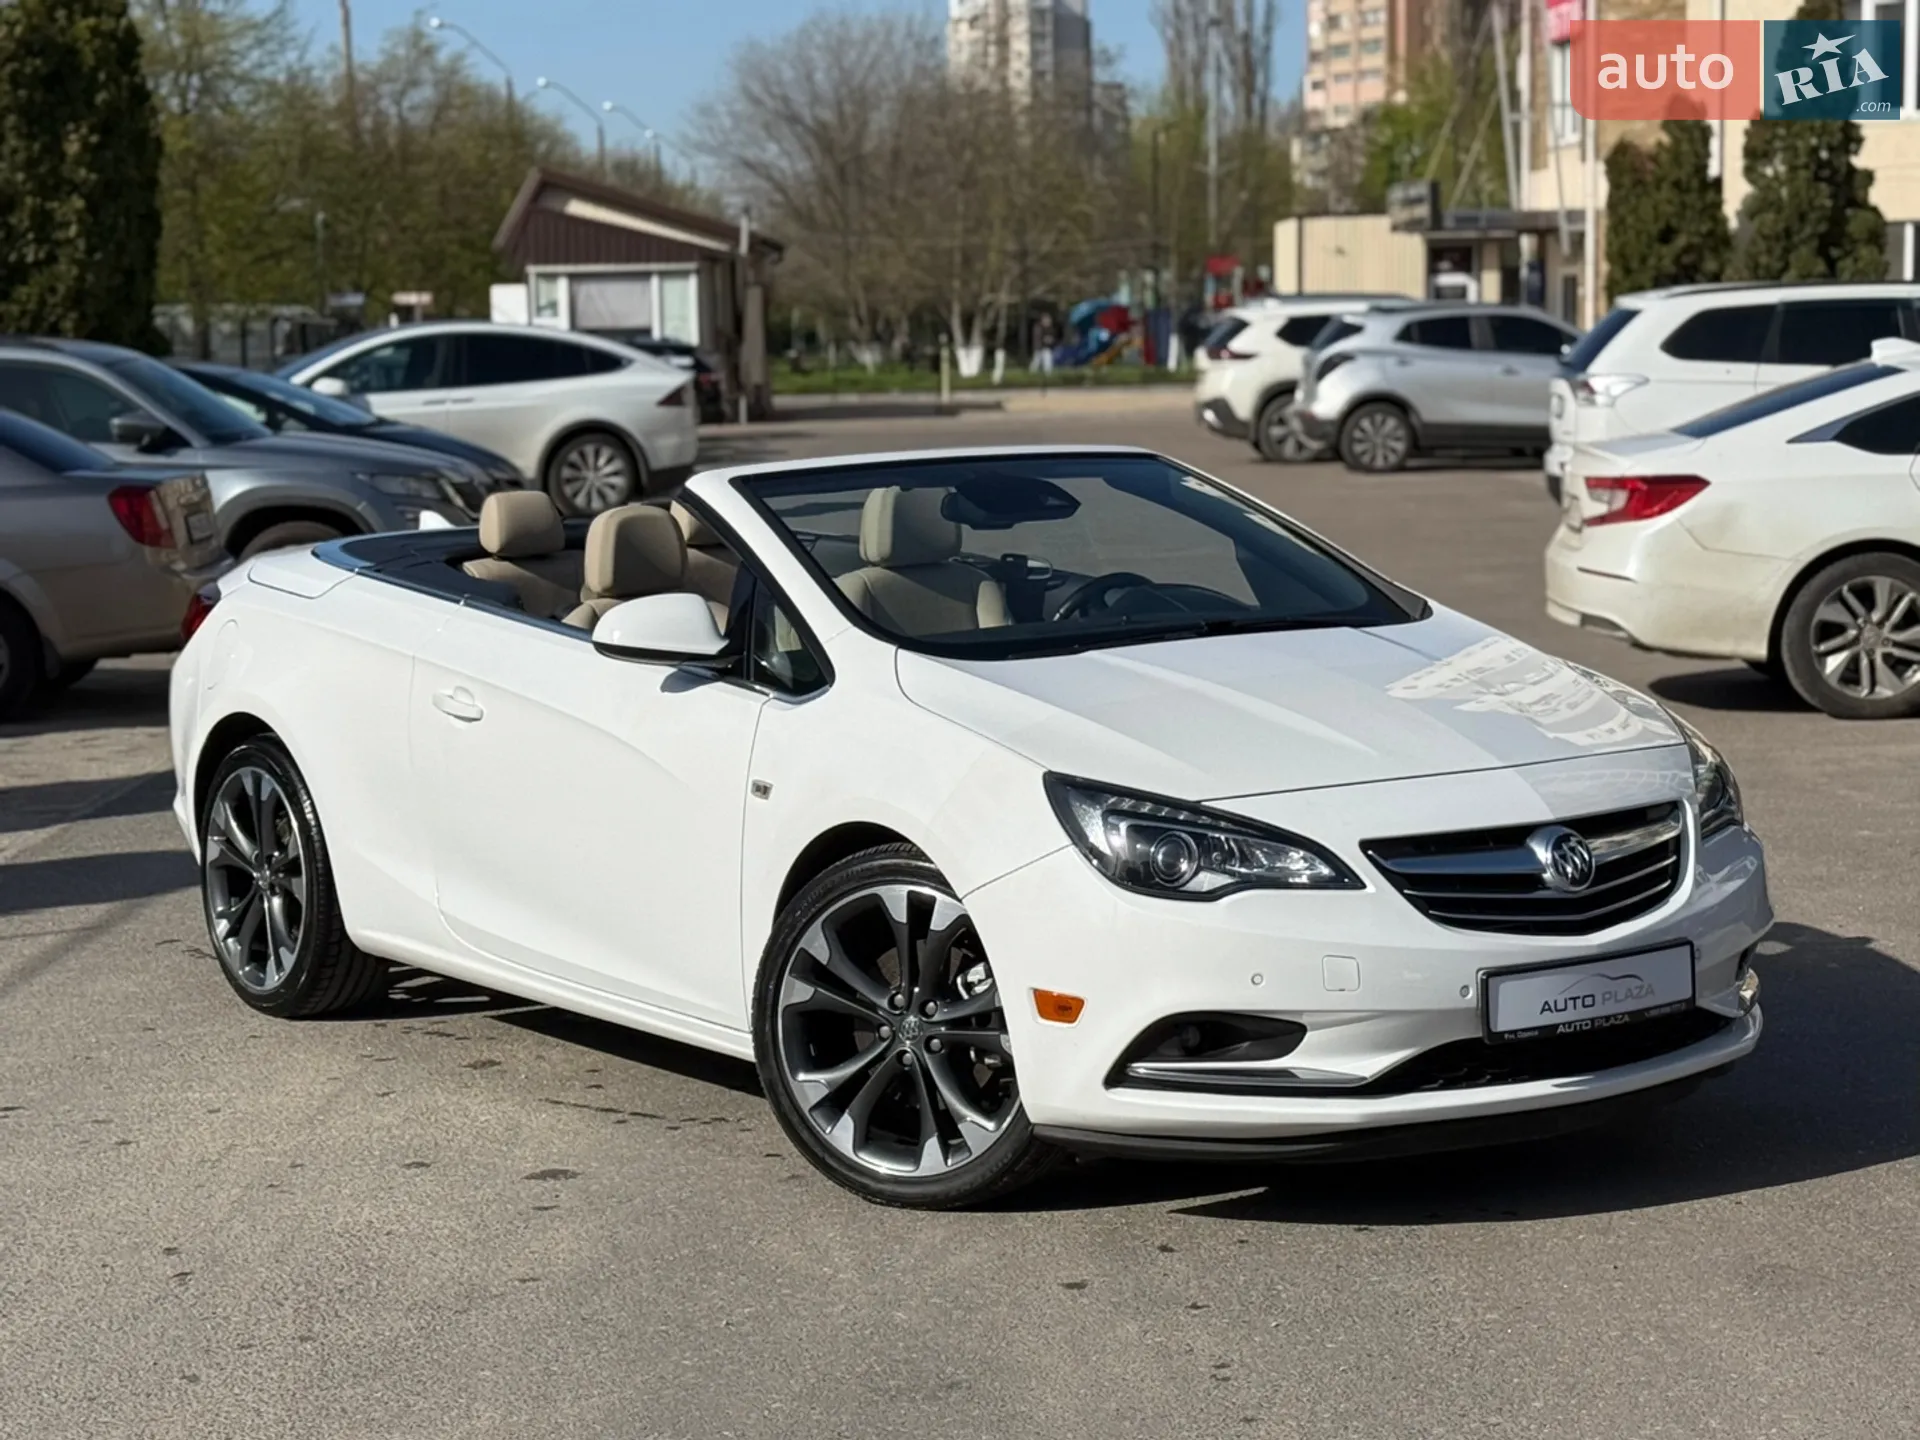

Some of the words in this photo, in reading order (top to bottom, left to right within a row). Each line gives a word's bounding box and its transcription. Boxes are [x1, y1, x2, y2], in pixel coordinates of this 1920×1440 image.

[1539, 993, 1596, 1016] AUTO
[1601, 984, 1656, 1006] PLAZA
[1556, 1020, 1592, 1035] AUTO
[1594, 1014, 1631, 1028] PLAZA
